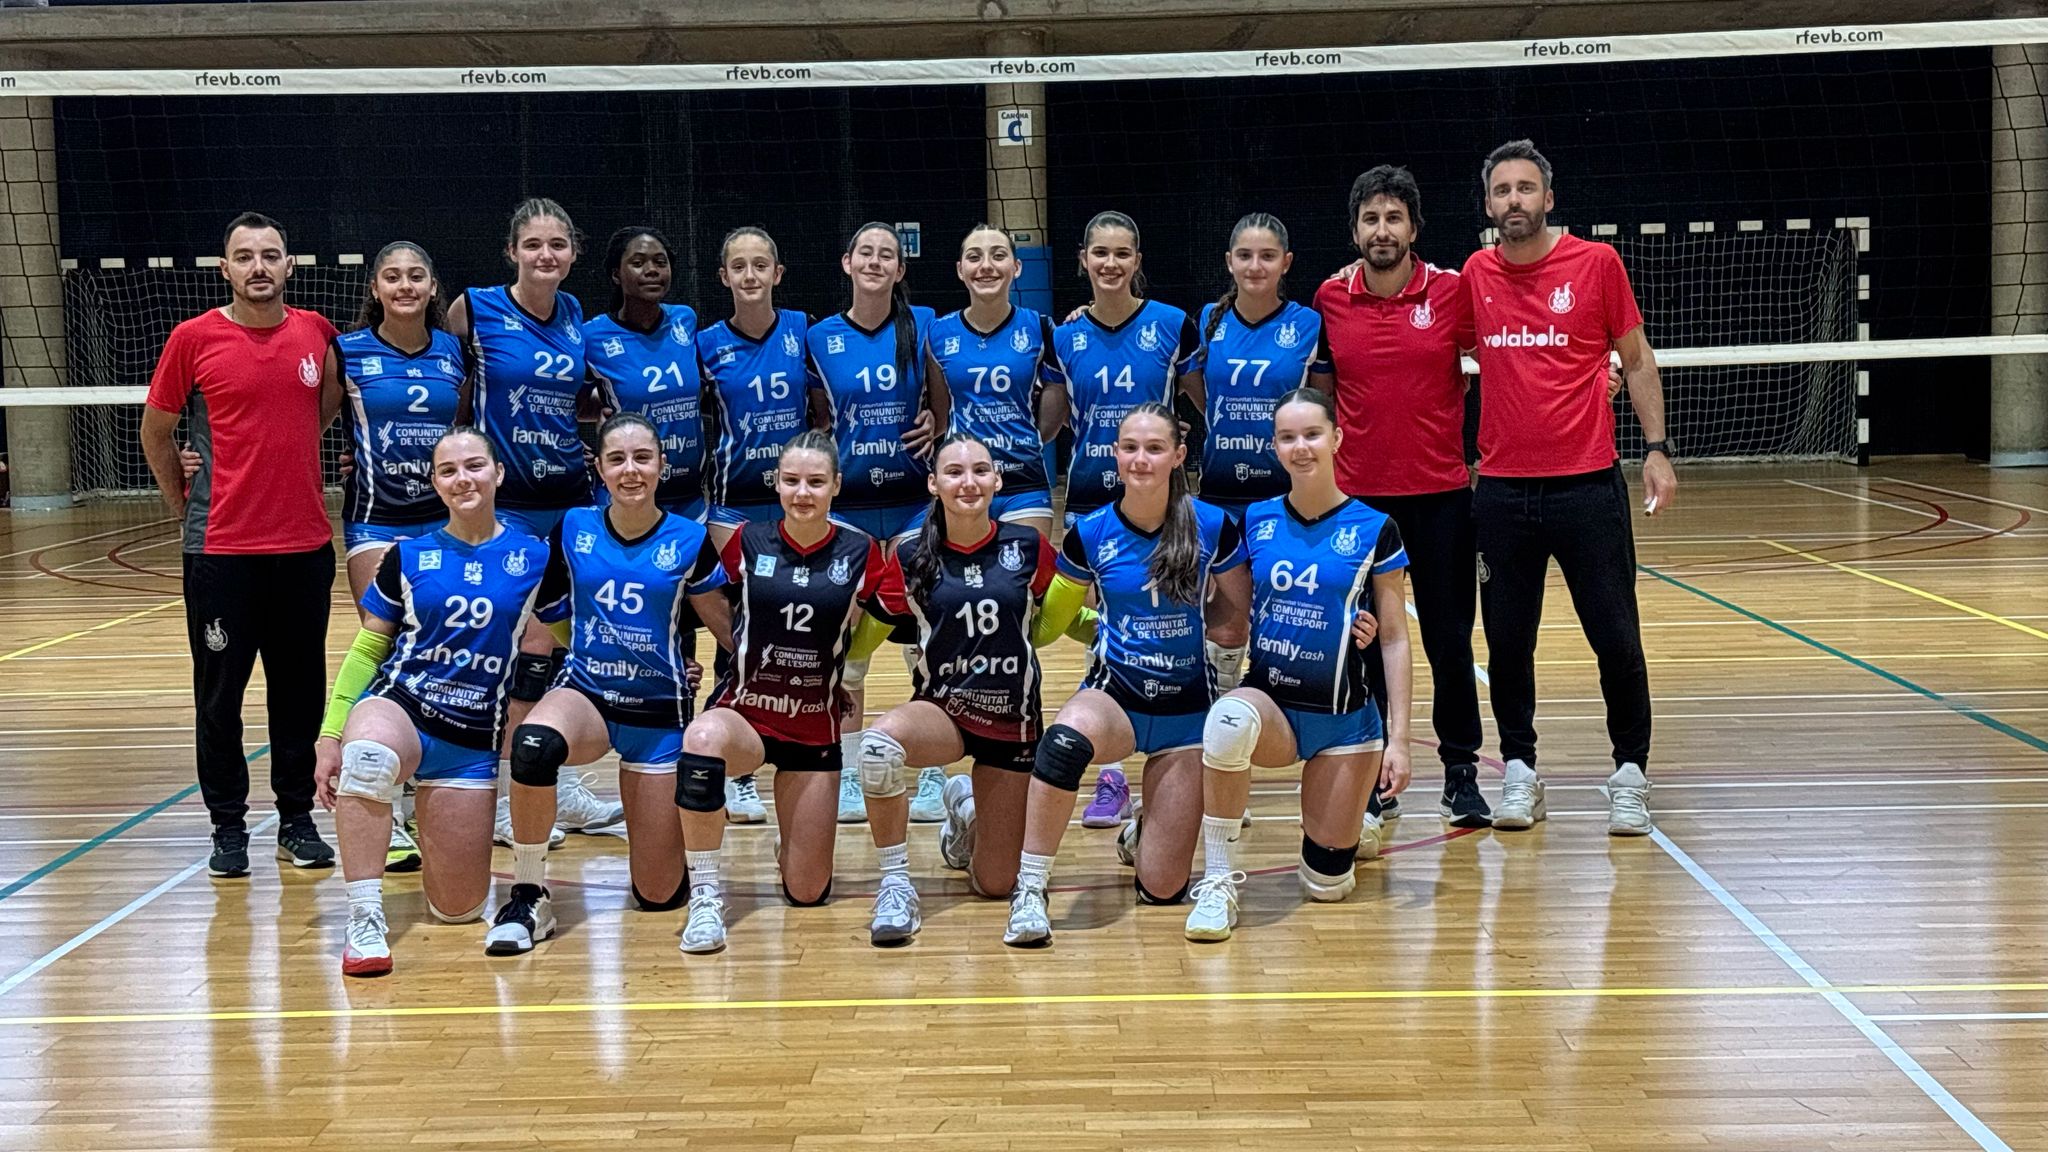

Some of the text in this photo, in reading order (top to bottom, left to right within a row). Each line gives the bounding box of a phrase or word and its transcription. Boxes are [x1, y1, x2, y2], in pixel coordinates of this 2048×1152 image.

[1797, 30, 1882, 44] rfevb.com
[1525, 42, 1610, 56] rfevb.com
[991, 61, 1075, 74] rfevb.com
[1256, 52, 1341, 66] rfevb.com
[196, 72, 280, 85] rfevb.com
[462, 70, 546, 83] rfevb.com
[727, 66, 811, 80] rfevb.com
[1008, 120, 1022, 142] C
[1483, 324, 1569, 348] volabola
[534, 350, 575, 382] 22
[1227, 358, 1272, 387] 77
[642, 361, 684, 393] 21
[855, 364, 898, 394] 19
[967, 365, 1012, 394] 76
[1094, 364, 1136, 394] 14
[747, 371, 790, 403] 15
[407, 384, 430, 413] 2
[530, 404, 543, 413] DE
[1095, 409, 1128, 419] COMUN
[1229, 411, 1274, 421] DE L'ESPO
[757, 424, 768, 432] DE
[863, 417, 875, 426] DE
[1099, 419, 1111, 428] DE
[400, 437, 438, 446] DE L'ESP
[512, 426, 560, 450] family
[661, 434, 686, 453] mily
[982, 434, 1014, 450] mily
[1215, 434, 1265, 454] family
[745, 443, 784, 460] famil
[851, 438, 897, 458] family
[1086, 441, 1114, 457] fam
[382, 459, 431, 477] family
[464, 560, 483, 572] MÉS
[964, 563, 982, 576] MÉS
[1269, 559, 1320, 596] 64
[593, 578, 645, 615] 45
[444, 595, 494, 629] 29
[779, 602, 815, 633] 12
[955, 598, 1000, 639] 18
[1272, 603, 1324, 620] COMUNITAT
[1132, 618, 1188, 631] COMUNITAT
[1273, 613, 1329, 630] DE L'ESPORT
[602, 634, 615, 644] DE
[1137, 626, 1194, 639] DE L'ESPORT
[774, 651, 818, 661] COMUNITAT
[1256, 633, 1325, 662] family cash
[416, 643, 503, 675] ahora
[788, 661, 822, 669] L'ESPORT
[938, 654, 1019, 677] ahora
[1123, 652, 1196, 670] family cash
[586, 657, 639, 681] family
[424, 681, 487, 701] COMUNITAT
[949, 692, 1010, 705] MUNITAT
[425, 691, 490, 711] DE L'ESPORT
[739, 688, 803, 718] family
